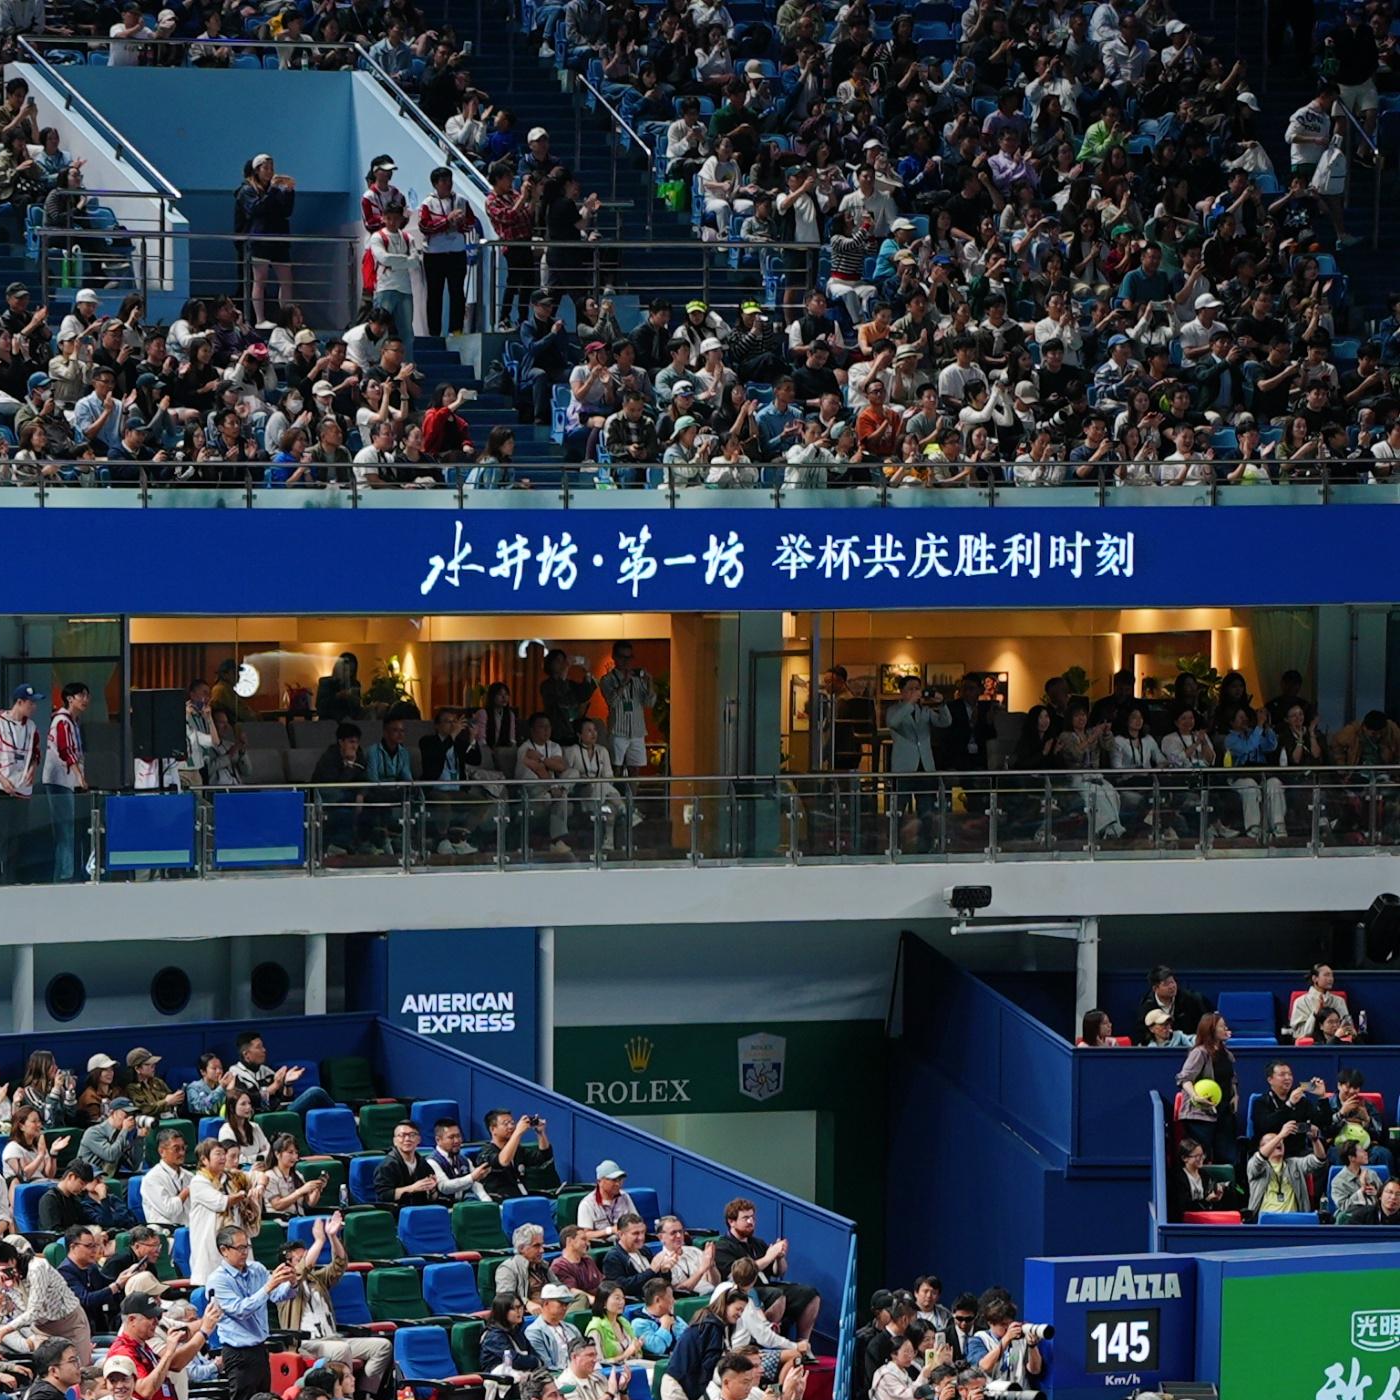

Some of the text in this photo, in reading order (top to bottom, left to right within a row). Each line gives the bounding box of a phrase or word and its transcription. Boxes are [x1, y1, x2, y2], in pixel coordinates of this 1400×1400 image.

[419, 520, 1136, 598] 水井坊·第一坊 举杯共庆胜利时刻
[401, 992, 514, 1014] AMERICAN
[417, 1013, 516, 1034] EXPRESS
[585, 1079, 691, 1105] ROLEX
[1066, 1265, 1181, 1303] LAVAZZA
[1090, 1321, 1150, 1363] 145
[1105, 1374, 1141, 1386] Km/h
